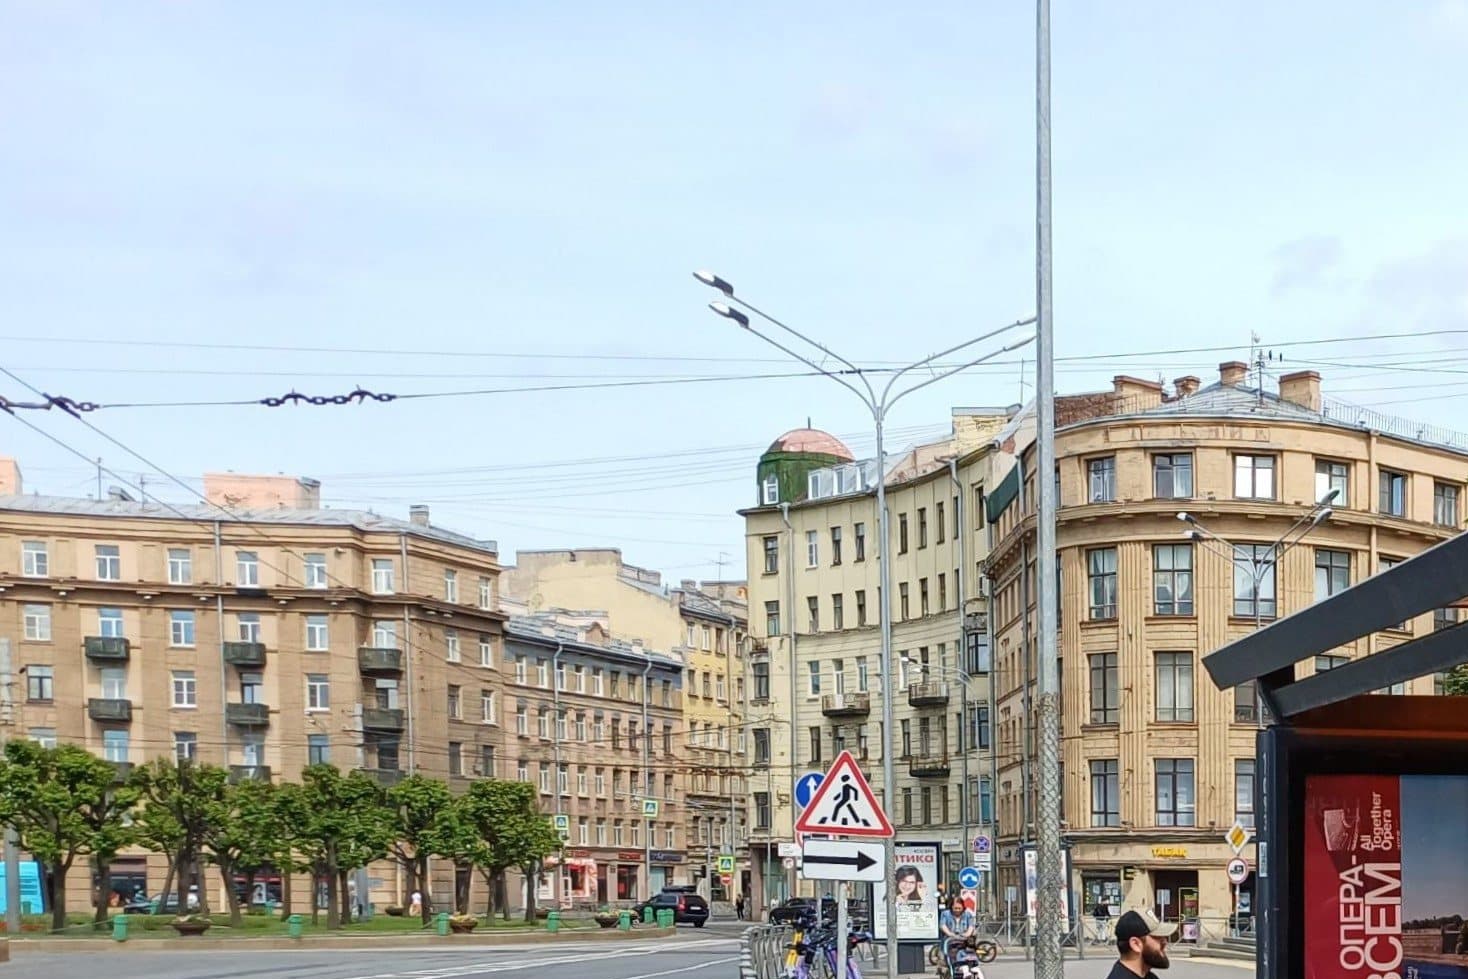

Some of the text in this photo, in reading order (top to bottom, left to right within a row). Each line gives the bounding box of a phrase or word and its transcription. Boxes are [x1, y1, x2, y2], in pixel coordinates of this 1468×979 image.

[1360, 834, 1373, 850] All
[1369, 791, 1384, 851] Together
[1381, 809, 1395, 851] Opera
[1339, 855, 1364, 970] ОПЕРА-
